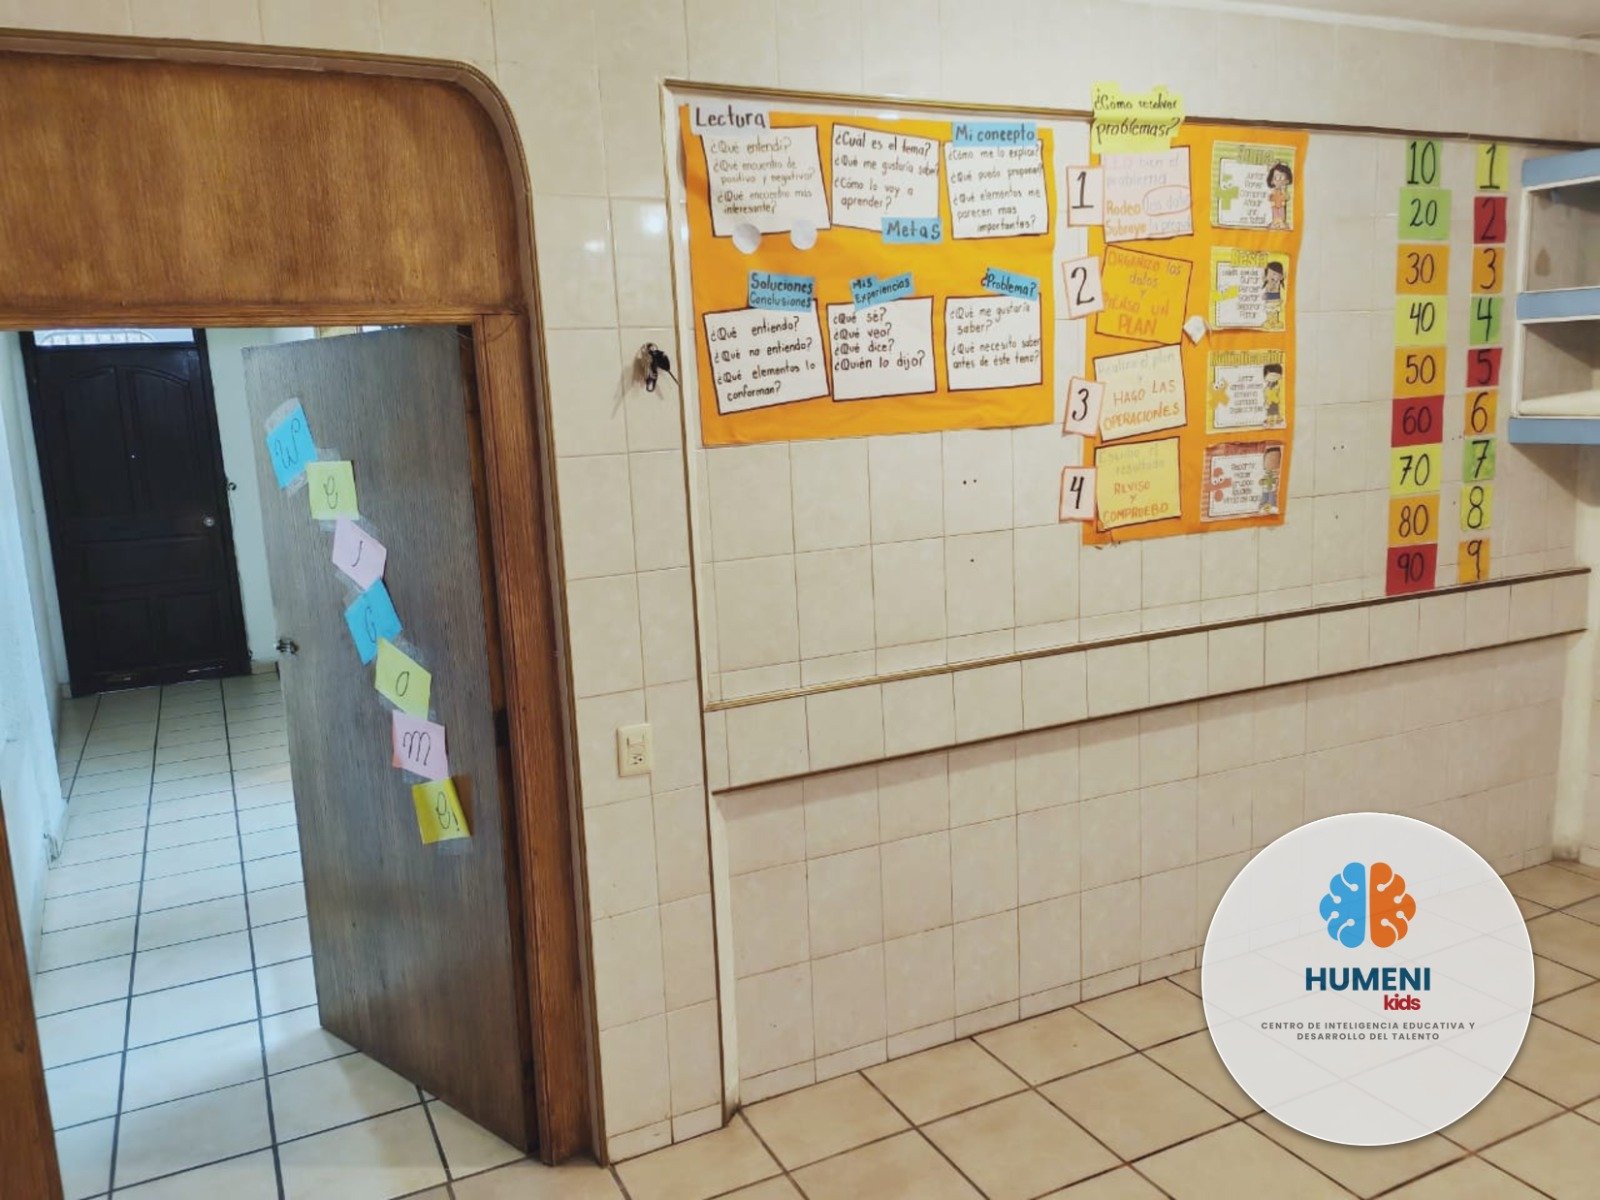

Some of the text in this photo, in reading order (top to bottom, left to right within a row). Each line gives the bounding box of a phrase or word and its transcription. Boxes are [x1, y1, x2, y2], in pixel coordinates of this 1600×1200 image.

[696, 104, 765, 128] Lectura
[872, 140, 882, 150] es
[888, 135, 897, 150] el
[956, 122, 1035, 143] Mi concepto
[1096, 117, 1180, 144] problemas?
[786, 156, 797, 169] de
[980, 150, 994, 158] me
[998, 146, 1004, 158] lo
[1407, 141, 1436, 184] 10
[864, 161, 876, 170] me
[1480, 142, 1500, 189] 1
[870, 178, 878, 190] lo
[886, 185, 900, 198] voy
[1072, 171, 1094, 209] 1
[841, 196, 891, 210] aprender?
[1410, 198, 1437, 227] 20
[886, 220, 940, 240] Metas
[1480, 196, 1496, 240] 2
[1406, 252, 1434, 284] 30
[1480, 248, 1496, 290] 3
[752, 272, 813, 294] Soluciones
[852, 278, 872, 290] Mis
[855, 278, 910, 304] Experiencias
[980, 268, 1037, 297] ¿Problema?
[1071, 266, 1095, 306] 2
[750, 292, 811, 308] Conclusiones
[980, 308, 992, 317] me
[711, 316, 800, 342] ¿Qué entiendo?
[868, 322, 892, 339] veo?
[958, 320, 993, 335] saber?
[1410, 302, 1435, 335] 40
[1477, 298, 1492, 341] 4
[767, 337, 812, 356] entiendo?
[868, 338, 894, 352] dice?
[752, 360, 800, 380] elementos
[806, 360, 816, 370] lo
[880, 357, 889, 368] lo
[896, 350, 926, 370] dijo?
[953, 358, 975, 370] antes
[980, 356, 988, 367] de
[1406, 354, 1436, 384] 50
[1477, 348, 1492, 384] 5
[727, 380, 782, 402] conforman?
[1152, 380, 1176, 394] LAS
[1072, 388, 1089, 422] 3
[1471, 392, 1488, 432] 6
[1402, 406, 1432, 436] 60
[1399, 453, 1430, 486] 70
[1472, 440, 1490, 478] 7
[1070, 476, 1084, 510] 4
[1467, 486, 1484, 528] 8
[1399, 504, 1428, 538] 80
[1398, 552, 1424, 584] 90
[1467, 540, 1482, 580] 9
